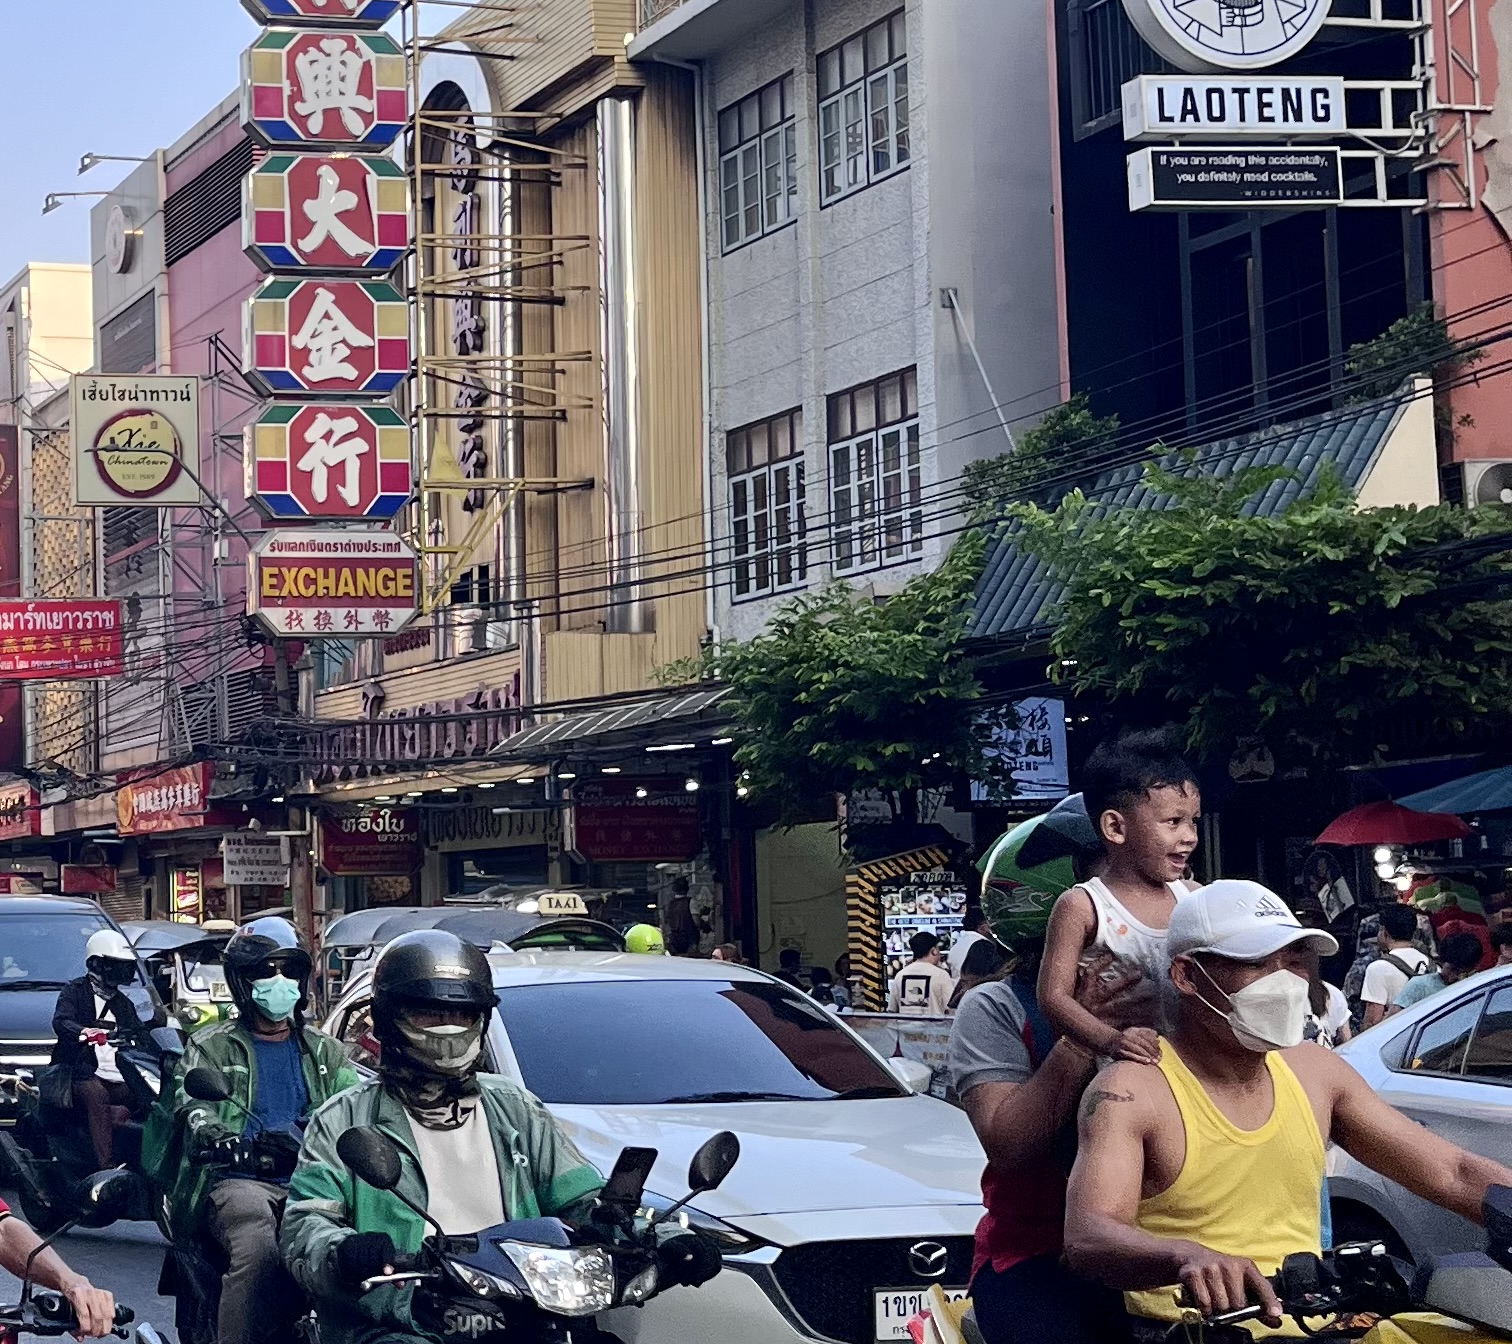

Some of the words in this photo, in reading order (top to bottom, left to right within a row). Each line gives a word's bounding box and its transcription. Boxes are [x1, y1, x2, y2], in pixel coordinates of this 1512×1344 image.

[1157, 87, 1331, 123] LAOTENG
[1170, 156, 1188, 167] you
[1190, 156, 1207, 166] are
[1209, 155, 1246, 168] reading
[1248, 155, 1266, 166] this
[1177, 172, 1195, 184] you
[269, 540, 401, 554] รับแลกเงินตราต่างประเทศ
[262, 567, 414, 598] EXCHANGE
[546, 897, 579, 909] TAXI
